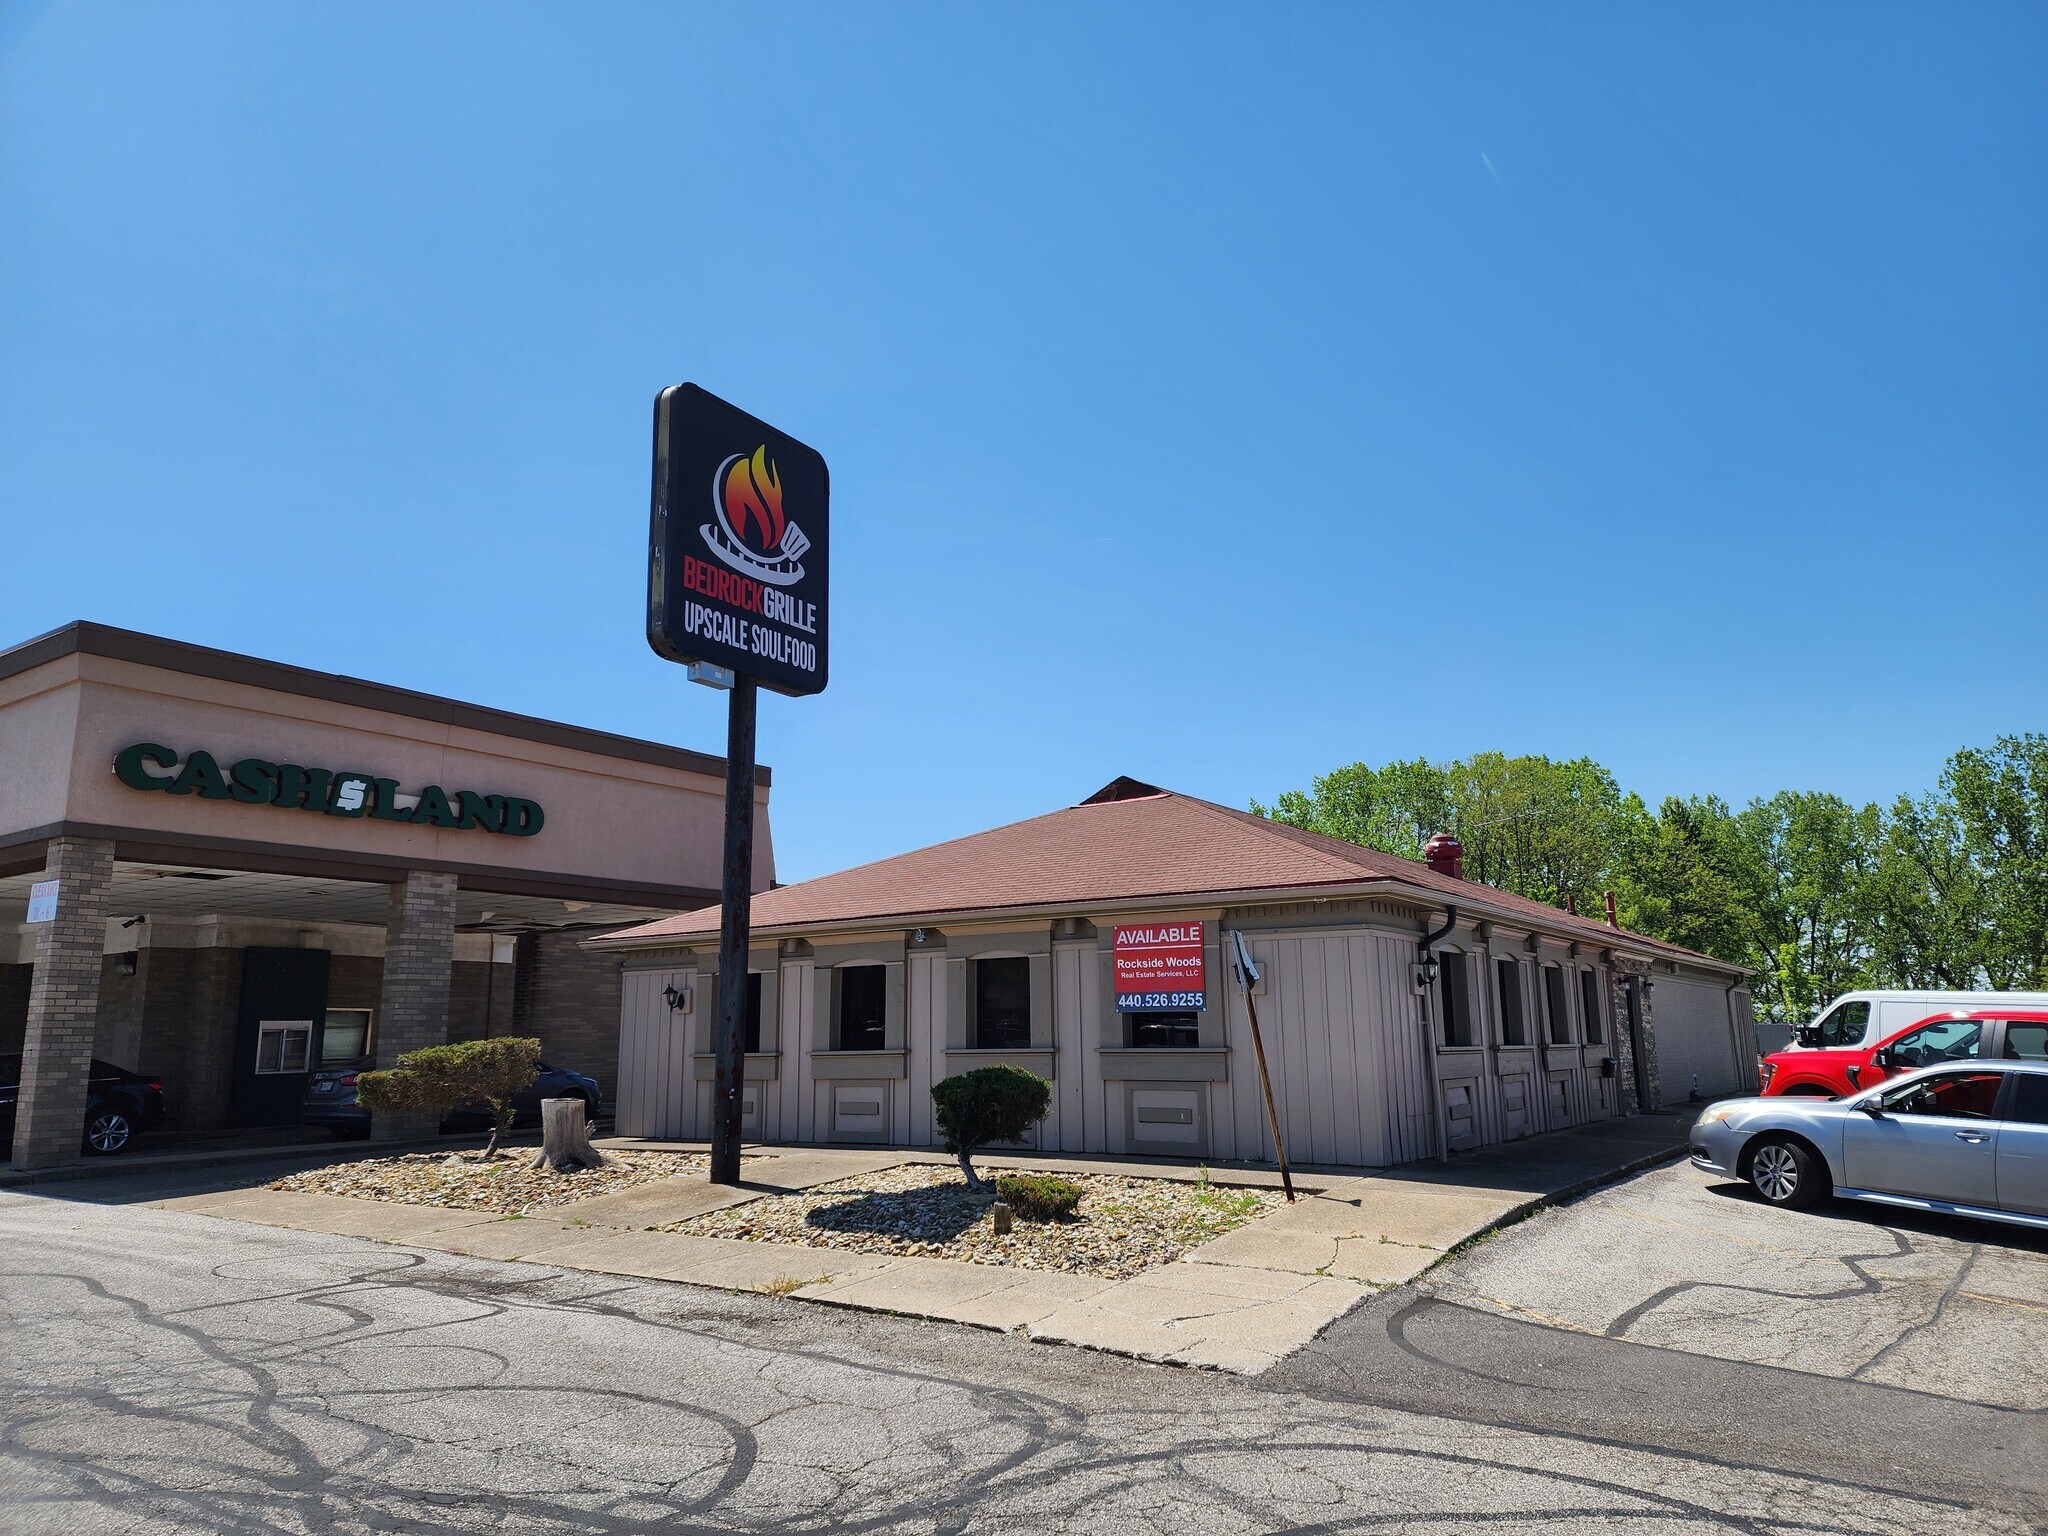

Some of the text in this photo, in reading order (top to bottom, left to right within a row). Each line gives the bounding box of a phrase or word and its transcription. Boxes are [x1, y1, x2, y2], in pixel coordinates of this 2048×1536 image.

[684, 600, 816, 672] UPSCALE SOULFOOD
[1116, 926, 1200, 945] AVAILABLE
[1117, 956, 1202, 969] Rockside Woods
[1156, 970, 1185, 978] Services,
[1186, 969, 1199, 977] LLC
[1118, 993, 1203, 1007] 440.526.9255
